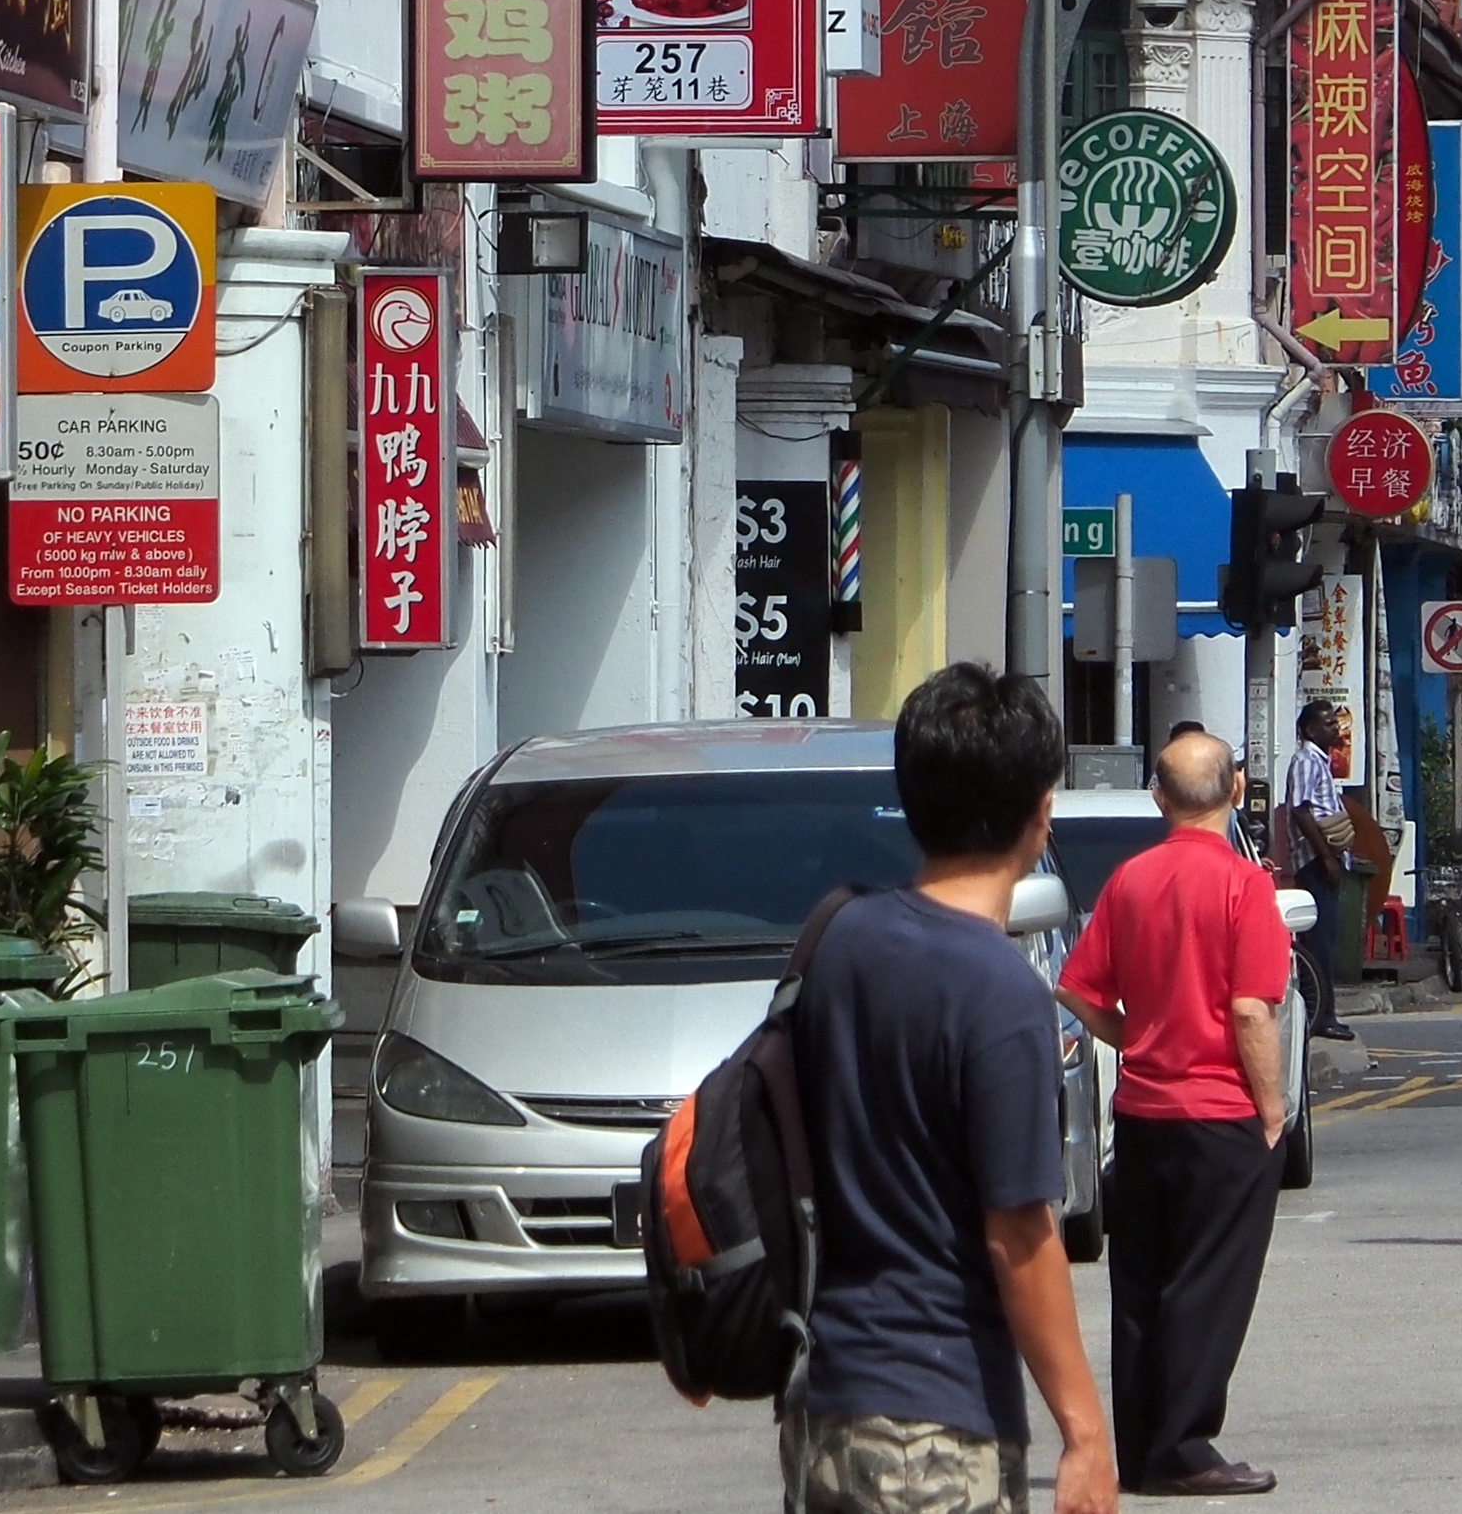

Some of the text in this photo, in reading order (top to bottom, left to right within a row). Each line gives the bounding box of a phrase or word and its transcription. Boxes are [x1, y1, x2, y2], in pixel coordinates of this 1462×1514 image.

[635, 42, 707, 75] 257
[888, 99, 979, 147] 上海
[64, 215, 179, 330] P
[62, 339, 163, 355] Coupon Parking
[369, 363, 437, 416] 九九
[57, 419, 167, 434] CAR PARKING
[18, 440, 65, 460] 50¢
[85, 445, 136, 458] 8.30am
[145, 445, 195, 460] 5.00pm
[1346, 427, 1413, 462] 经济
[32, 464, 76, 478] Hourly
[85, 463, 139, 477] Monday
[150, 462, 210, 477] Saturday
[13, 480, 38, 492] (Free
[41, 479, 76, 492] Parking
[80, 480, 93, 491] On
[166, 479, 205, 492] Holiday)
[1348, 467, 1412, 500] 早餐
[57, 506, 171, 523] NO PARKING
[735, 495, 788, 552] $3
[43, 530, 186, 544] OF HEAVY VEHICLES
[81, 548, 97, 564] kg
[130, 548, 141, 560] &
[735, 554, 782, 569] ash Hair
[21, 567, 55, 579] From
[59, 566, 111, 581] 10.00pm
[124, 566, 172, 578] 8.30am
[176, 565, 208, 580] daily
[16, 581, 213, 597] Except Season Ticket Holders
[735, 591, 788, 648] $5
[736, 652, 802, 667] ut Hair (Man)
[127, 736, 153, 747] OUTSIDE
[153, 736, 170, 747] FOOD
[177, 736, 199, 746] DRINKS
[132, 749, 195, 760] ARE NOT ALLOWED TO
[126, 762, 152, 773] ONSUME
[136, 1041, 195, 1074] 251
